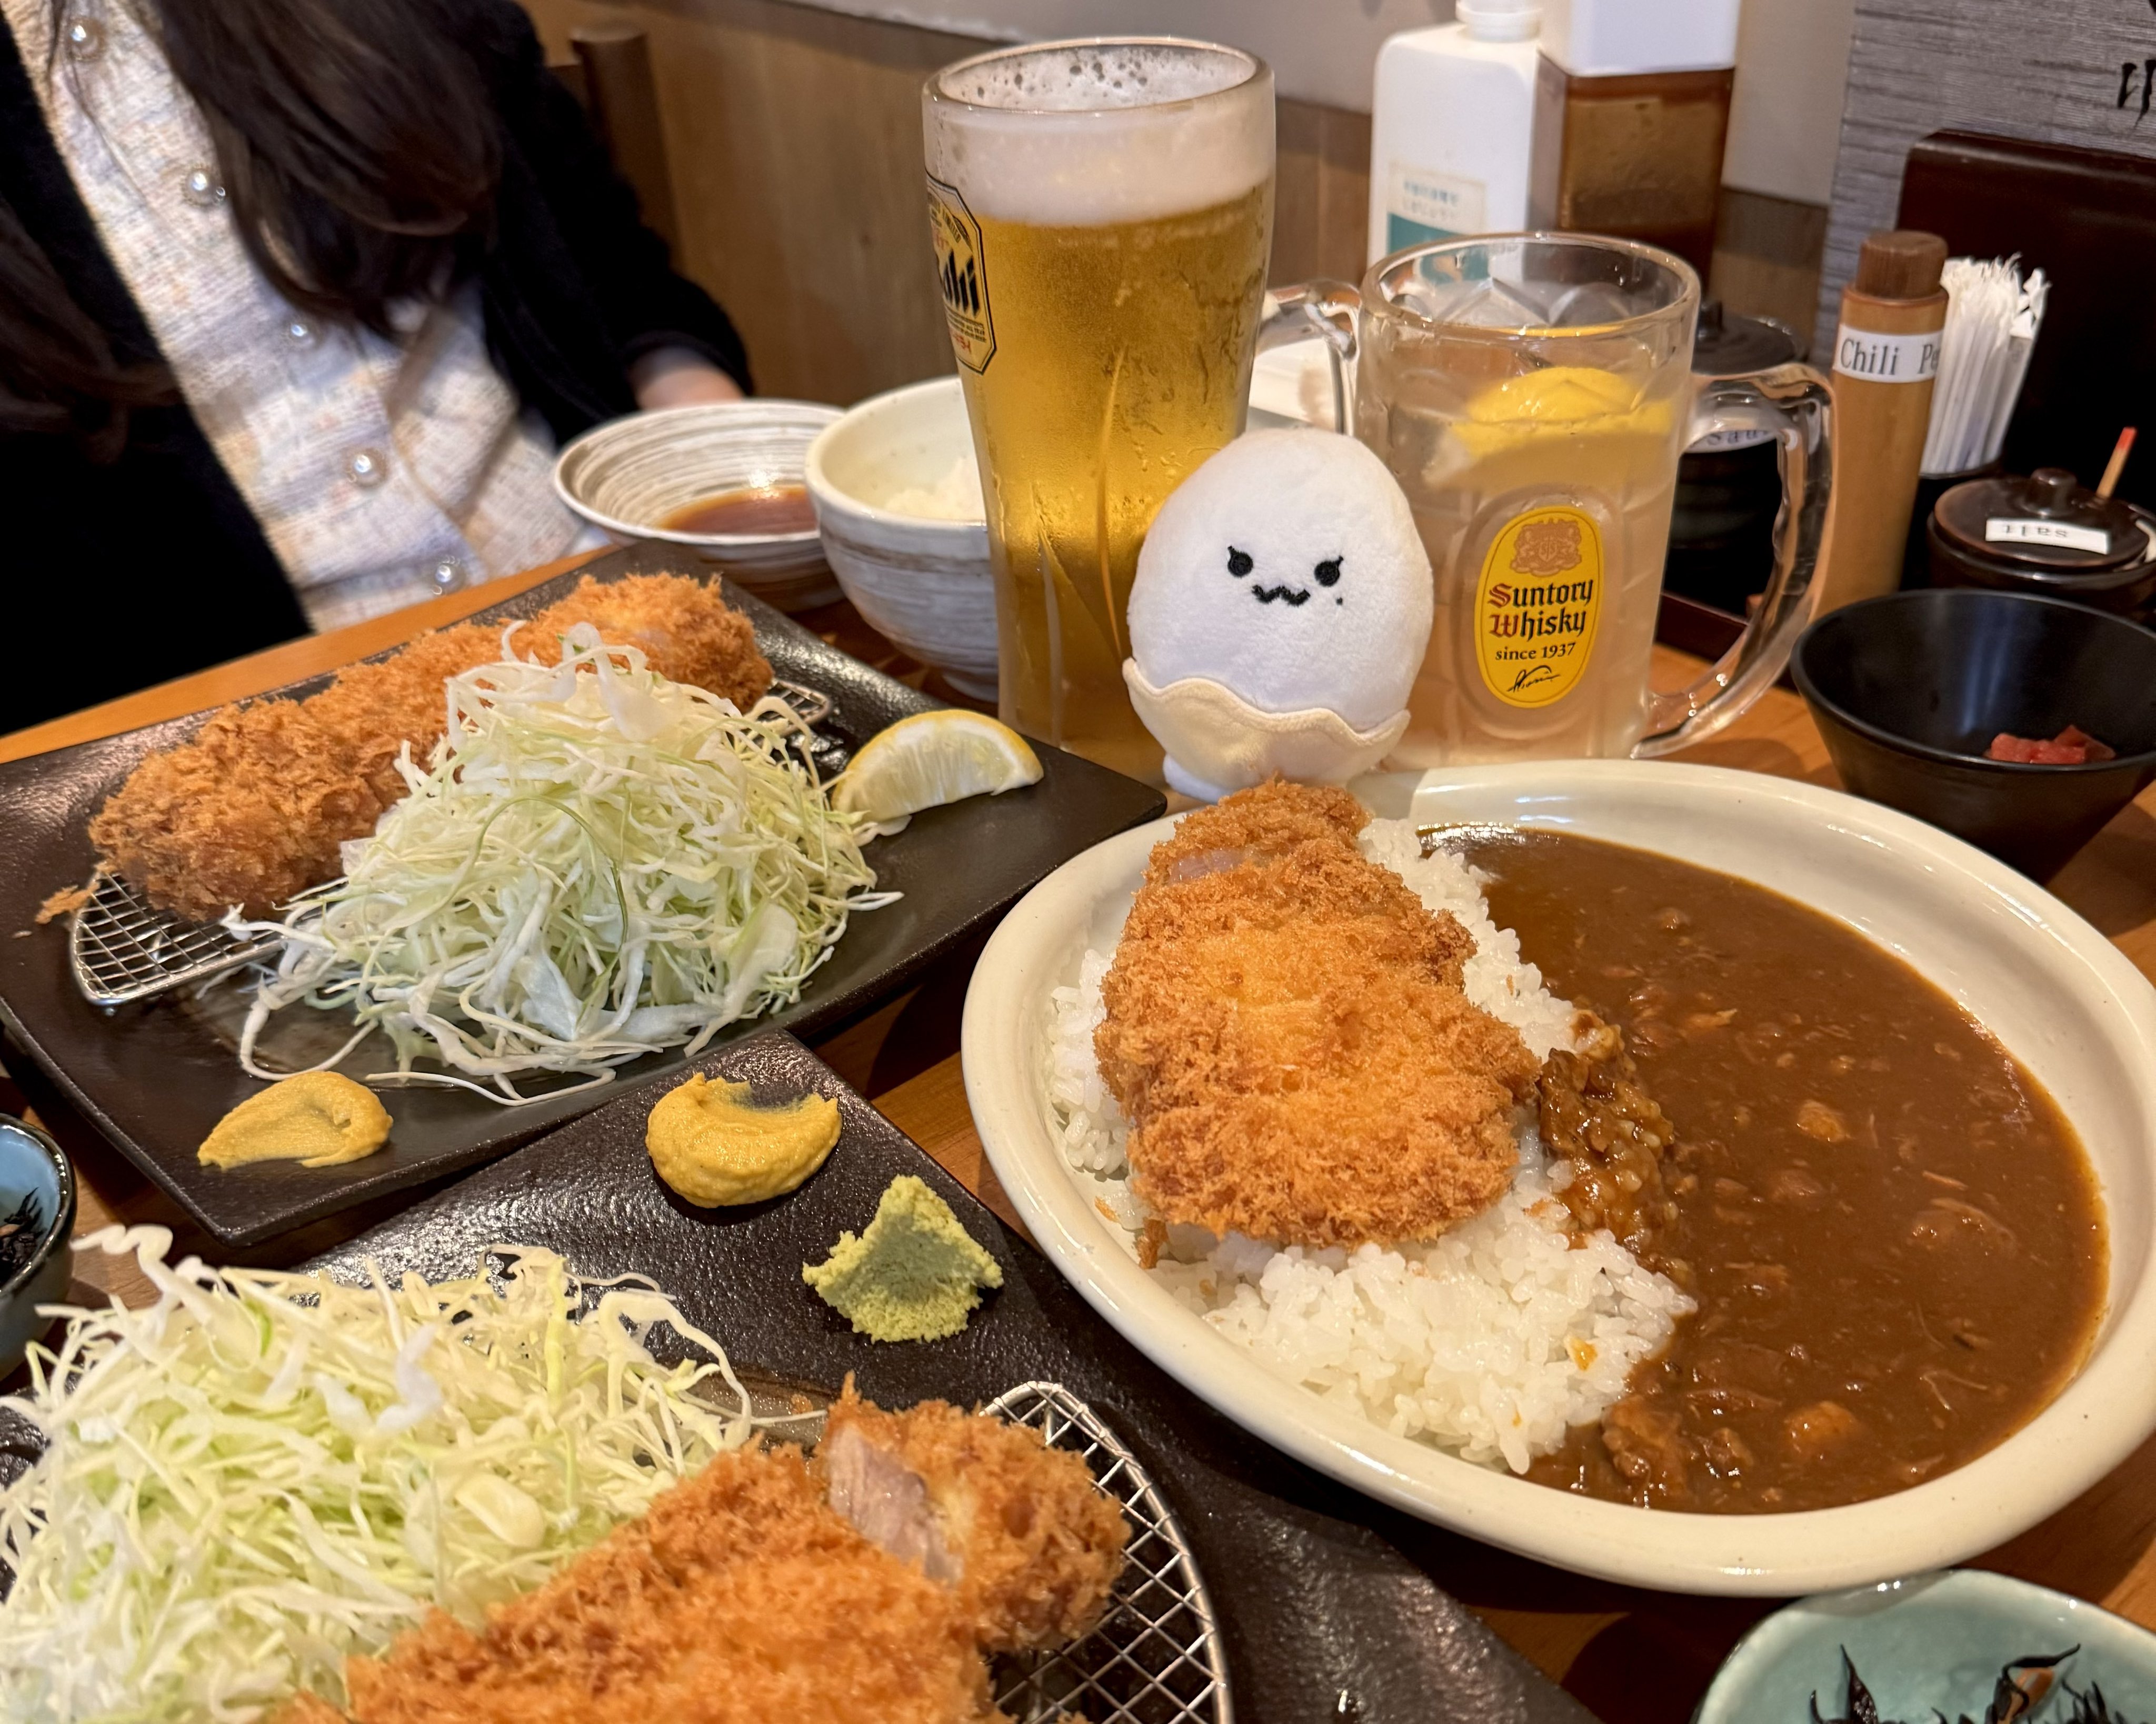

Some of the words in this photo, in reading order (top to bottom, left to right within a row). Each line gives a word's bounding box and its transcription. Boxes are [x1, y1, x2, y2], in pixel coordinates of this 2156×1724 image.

[1841, 338, 1900, 375] Chili
[1917, 344, 1941, 374] Pe
[1488, 580, 1593, 608] Suntory
[1488, 607, 1586, 642] Whisky
[1495, 646, 1536, 660] since
[1541, 642, 1575, 658] 1937
